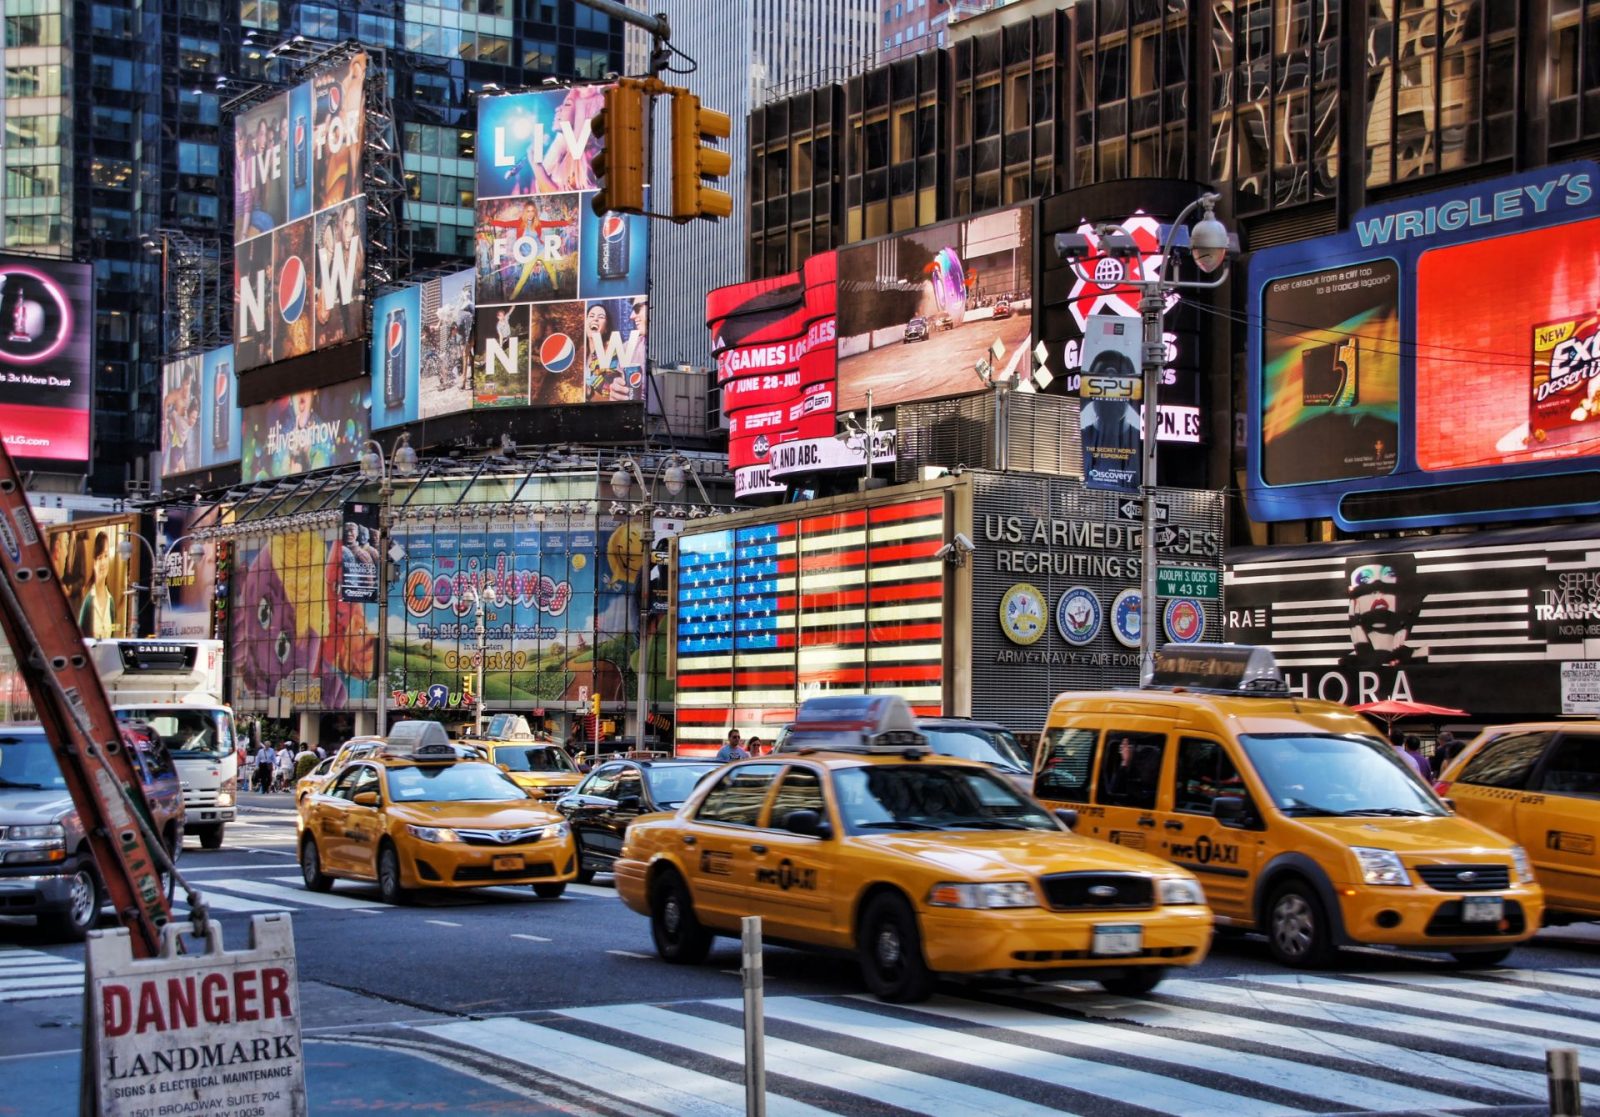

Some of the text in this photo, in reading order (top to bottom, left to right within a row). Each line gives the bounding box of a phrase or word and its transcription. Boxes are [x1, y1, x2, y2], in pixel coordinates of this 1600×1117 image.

[316, 110, 359, 160] FOR
[494, 118, 592, 167] LIV
[240, 143, 281, 194] LIVE
[1355, 173, 1593, 248] WRIGLEY'S
[493, 234, 564, 265] FOR
[1321, 273, 1338, 283] from
[1339, 273, 1345, 281] a
[1360, 267, 1373, 277] top
[1332, 280, 1360, 291] tropical
[1361, 274, 1391, 288] lagoon?
[1539, 327, 1566, 345] NEW
[731, 345, 786, 371] GAMES
[7, 373, 20, 383] 3x
[22, 374, 48, 385] More
[48, 376, 72, 387] Dust
[737, 377, 759, 393] JUNE
[1088, 379, 1133, 397] SPY
[1537, 365, 1589, 401] Dessert
[267, 419, 341, 455] #livefornow
[780, 447, 796, 467] AND
[800, 444, 822, 465] ABC.
[749, 469, 771, 489] JUNE
[1031, 518, 1121, 549] ARMED
[1127, 525, 1218, 556] FCES
[437, 556, 455, 569] The
[997, 549, 1121, 578] RECRUITING
[1159, 569, 1183, 581] ADOLPH
[1191, 571, 1207, 583] OCHS
[1209, 572, 1217, 583] ST
[1167, 583, 1208, 596] W 43 ST
[418, 623, 438, 640] The
[440, 623, 460, 640] BIG
[996, 651, 1031, 664] ARMY
[1041, 652, 1076, 665] NAVY
[1090, 653, 1110, 666] AIR
[1113, 653, 1142, 667] FORC
[1571, 662, 1597, 670] PALACE
[102, 967, 293, 1038] DANGER
[106, 1034, 297, 1080] LANDMARK
[114, 1065, 293, 1099] SIGNS & ELECTRICAL MAINTENANCE
[159, 1099, 224, 1116] BROADWAY,
[226, 1094, 260, 1107] SUITE
[261, 1091, 281, 1102] 704
